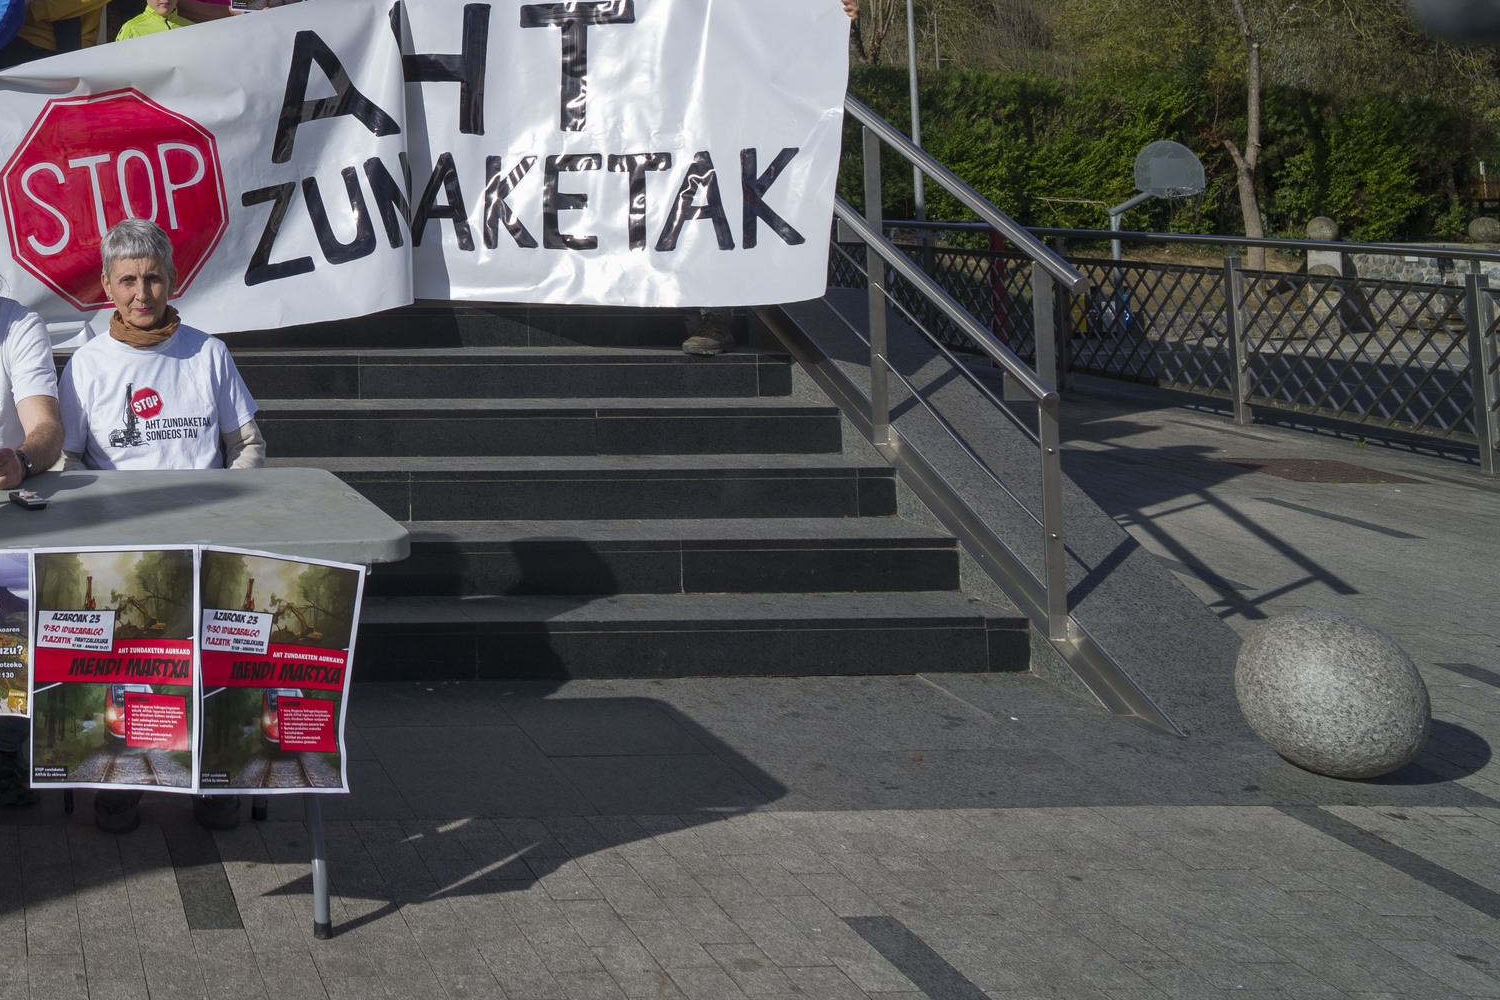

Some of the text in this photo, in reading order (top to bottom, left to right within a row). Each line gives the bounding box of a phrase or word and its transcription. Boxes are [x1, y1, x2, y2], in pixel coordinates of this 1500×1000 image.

[272, 0, 635, 164] AHT
[20, 142, 206, 255] STOP
[133, 395, 159, 413] STOP
[145, 417, 212, 430] AHT ZUNDAKETAK
[146, 429, 198, 442] SONDEOS TAV
[52, 613, 101, 623] AZAROAK 23
[213, 611, 259, 625] AZAROAK 23
[44, 624, 60, 632] 9:30
[207, 625, 221, 633] 9:30
[68, 658, 190, 678] MENDI MARTXA
[230, 661, 343, 685] MENDI MARTXA
